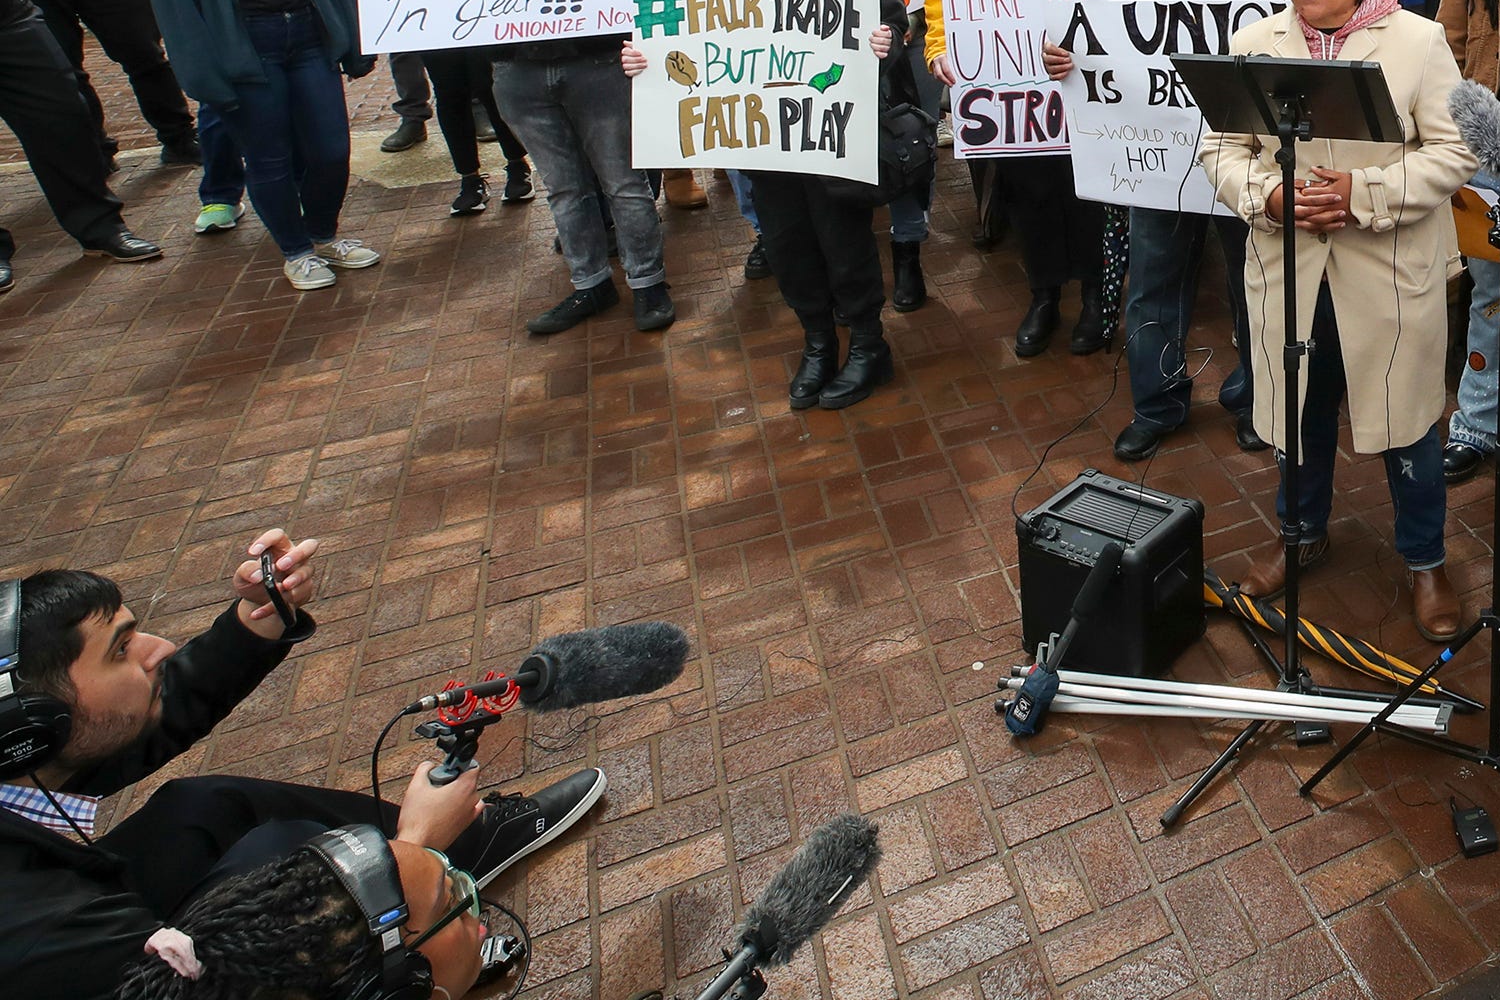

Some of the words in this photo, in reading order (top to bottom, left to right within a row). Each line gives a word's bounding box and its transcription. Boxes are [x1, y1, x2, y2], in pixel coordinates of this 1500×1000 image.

[494, 18, 586, 40] UNIONIZE
[1059, 2, 1108, 56] A
[1122, 1, 1287, 56] UNIO
[705, 42, 765, 87] BUT
[769, 44, 814, 81] NOT
[1081, 69, 1122, 104] IS
[679, 94, 770, 158] FAIR
[779, 97, 854, 158] PLAY
[958, 88, 1069, 146] STRO
[1104, 124, 1163, 142] WOULD
[1171, 130, 1194, 146] YOU
[1126, 147, 1168, 172] HOT
